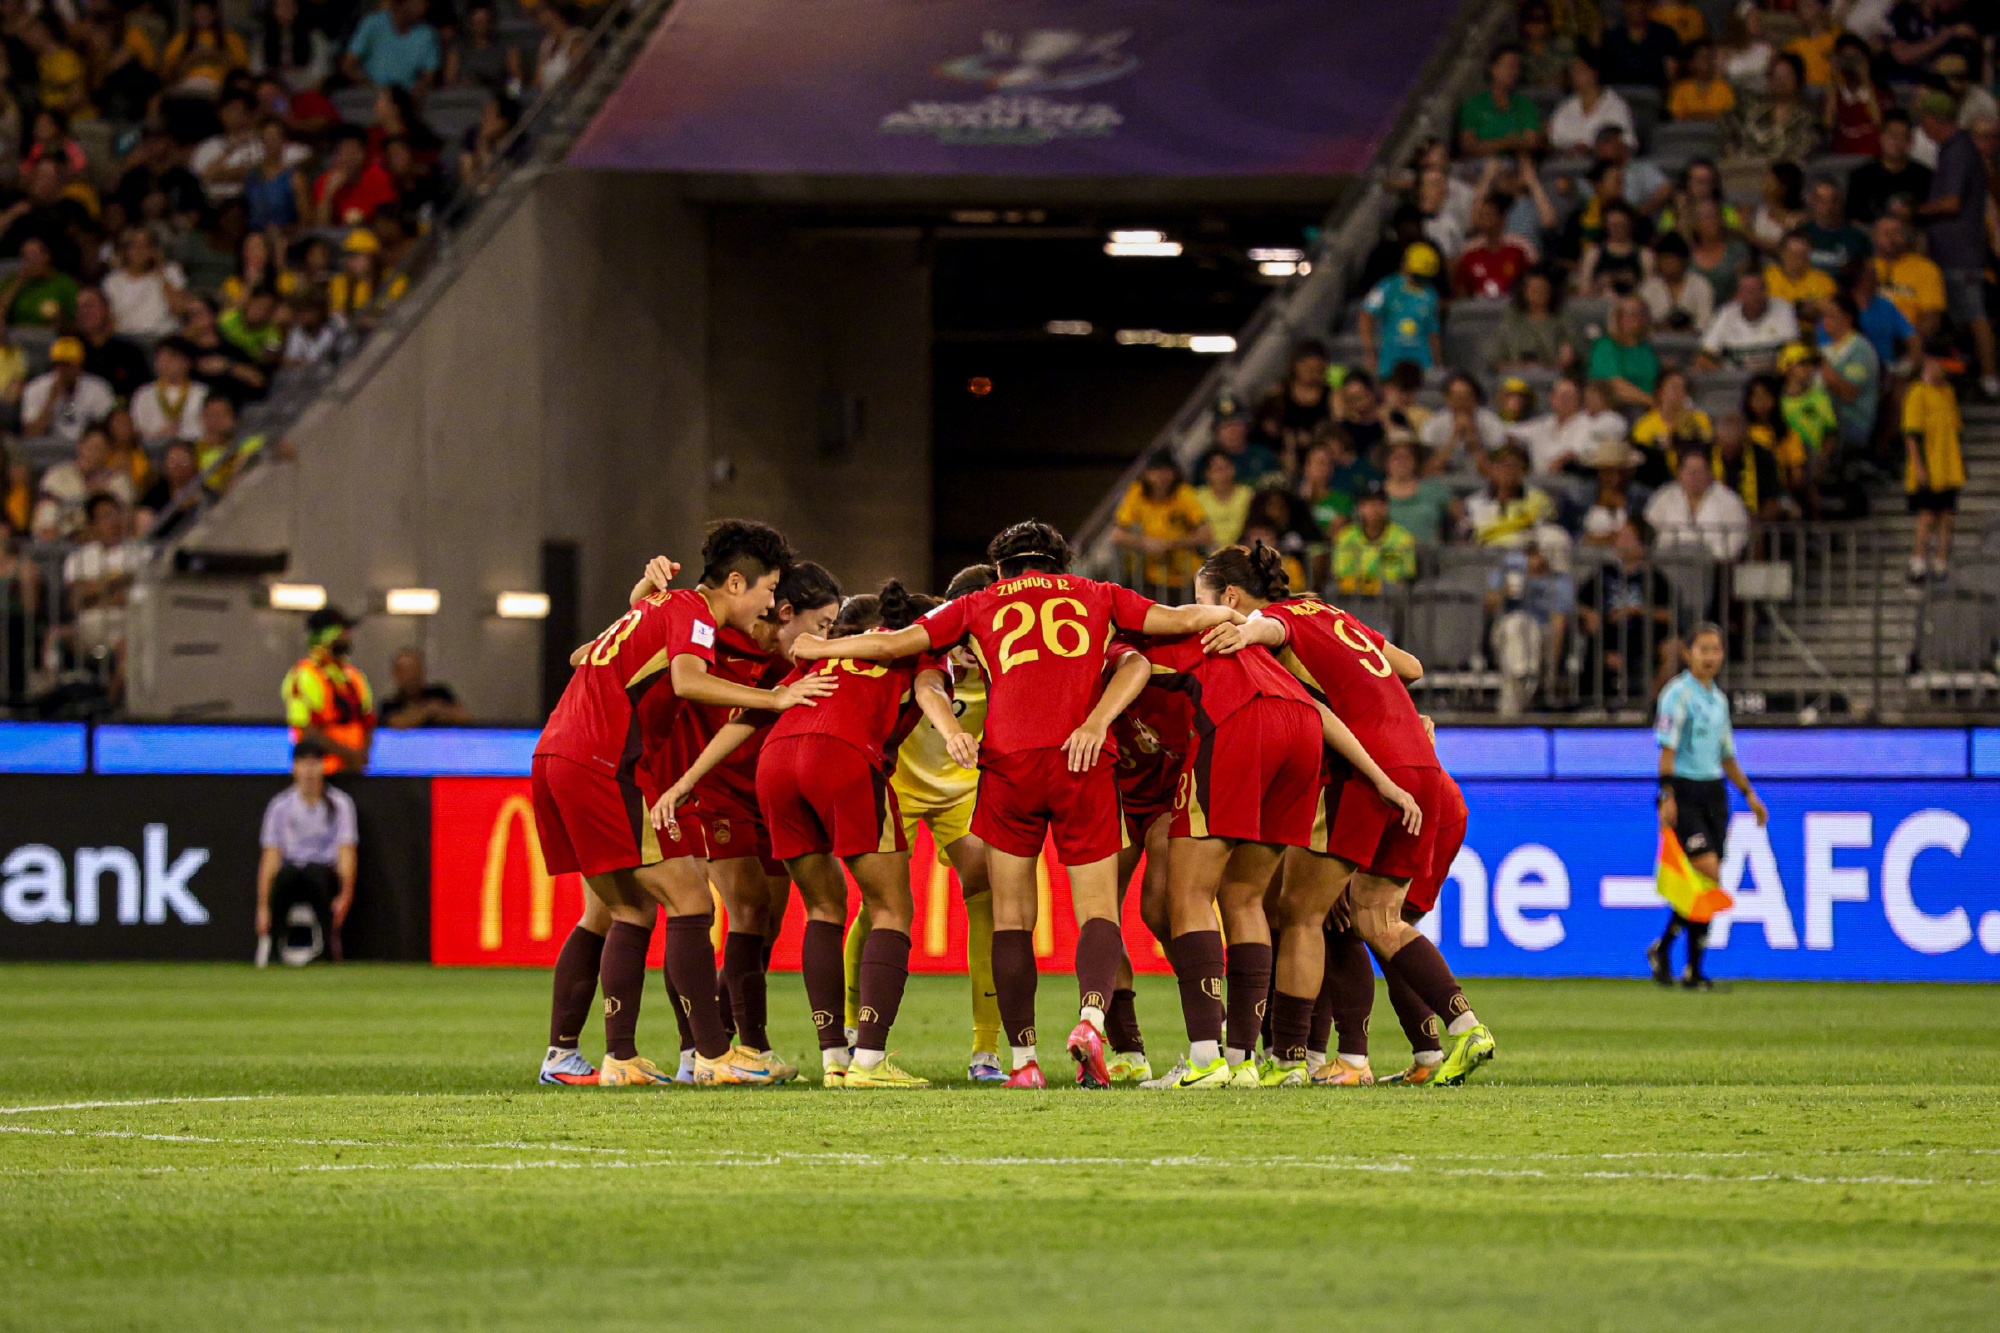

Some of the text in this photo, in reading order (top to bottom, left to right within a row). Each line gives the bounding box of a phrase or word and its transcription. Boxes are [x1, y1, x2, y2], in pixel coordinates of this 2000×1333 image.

[997, 577, 1053, 597] ZHANG
[992, 597, 1090, 675] 26
[1333, 618, 1393, 678] 9
[0, 822, 212, 926] ank
